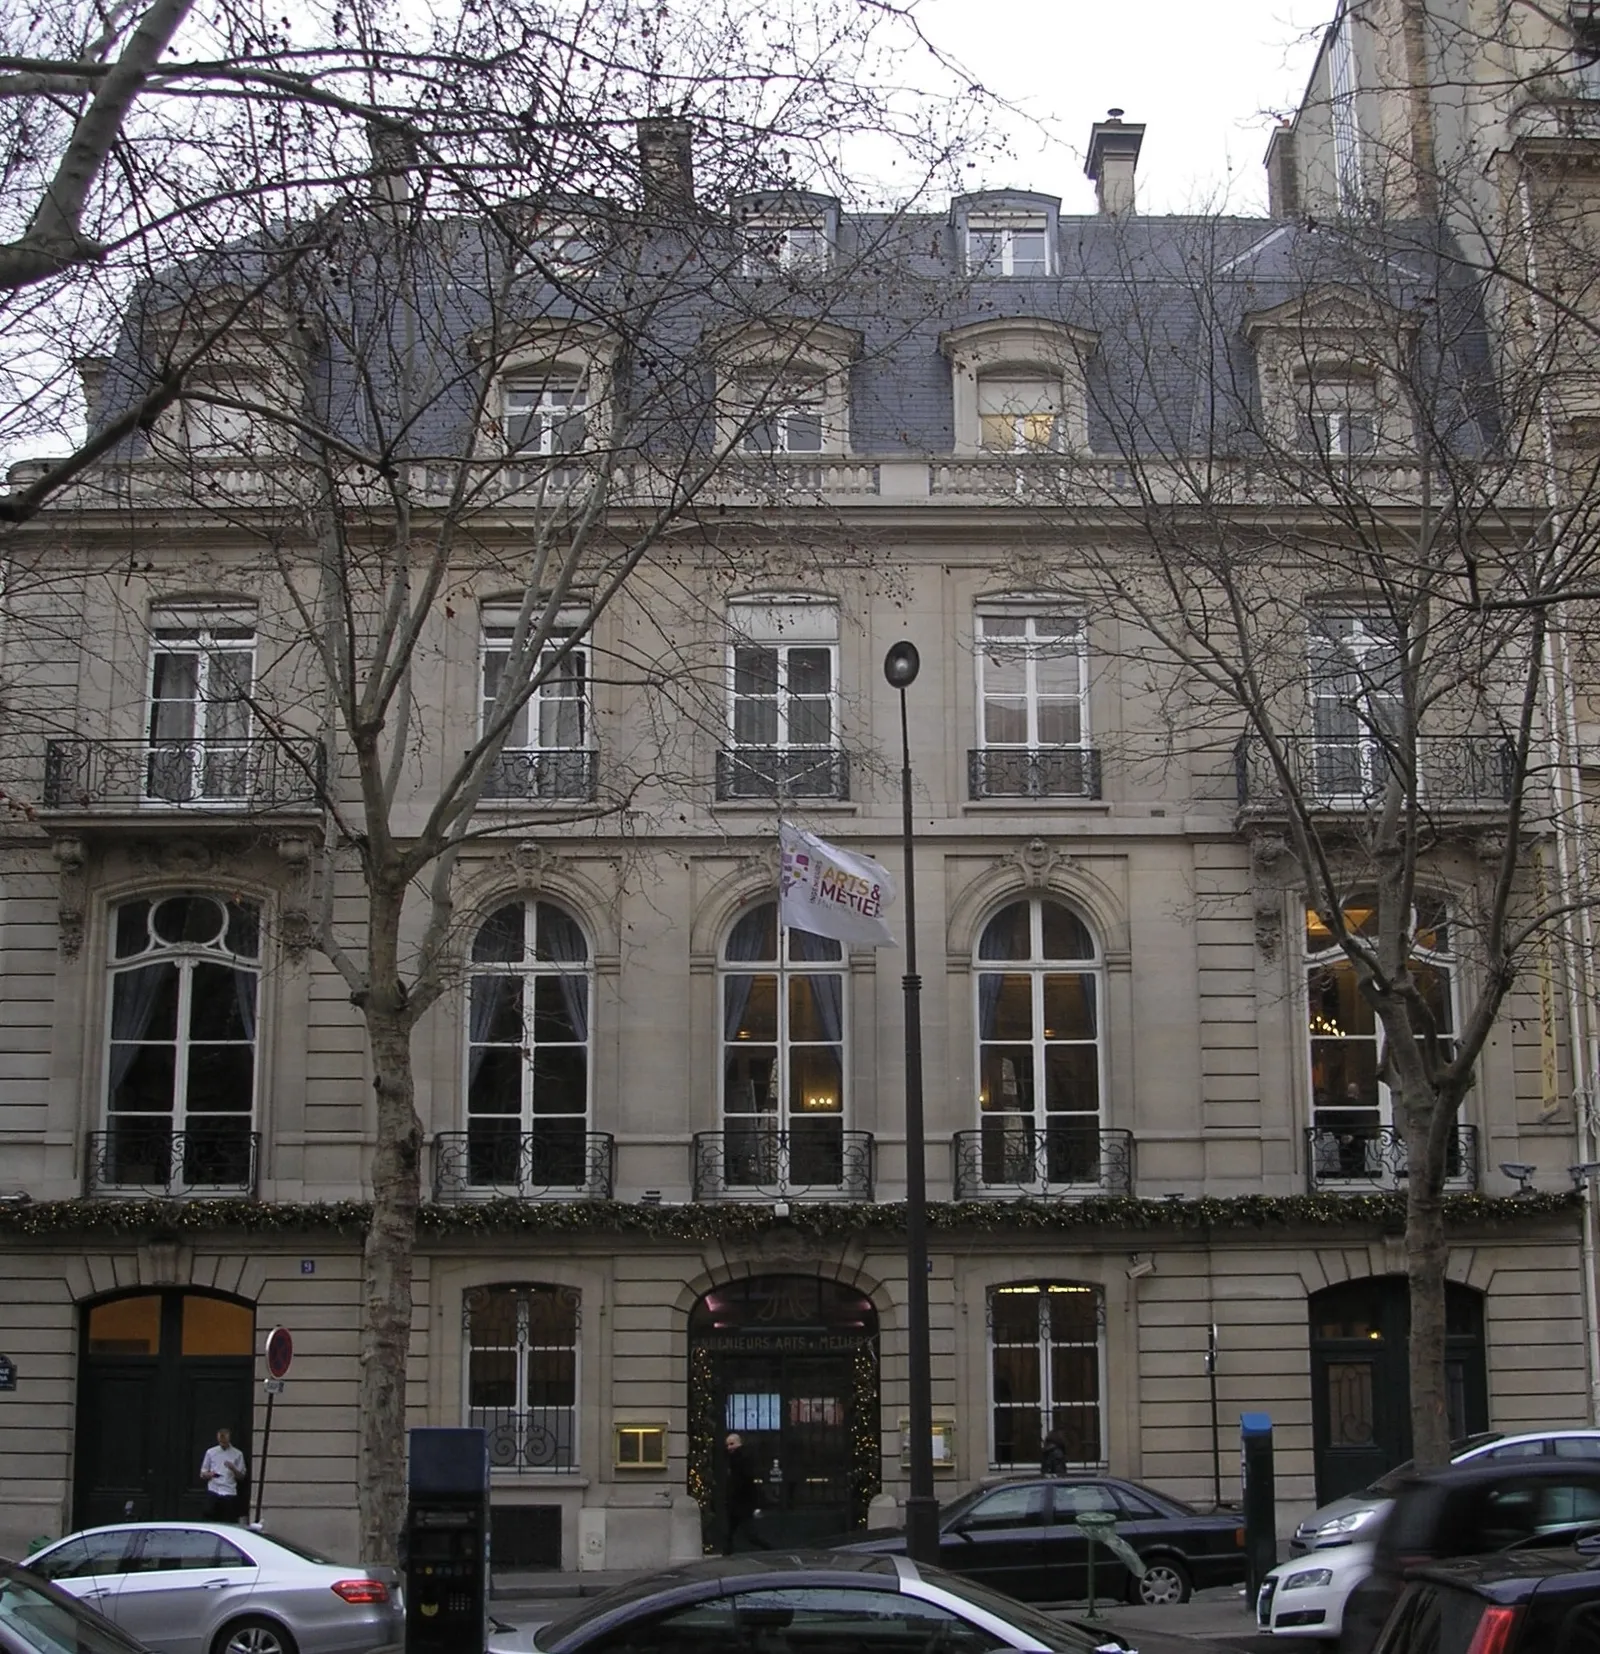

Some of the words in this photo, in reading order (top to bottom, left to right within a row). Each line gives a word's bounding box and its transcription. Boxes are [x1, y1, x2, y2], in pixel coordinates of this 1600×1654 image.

[823, 866, 870, 896] ARTS
[870, 884, 881, 901] &
[775, 1336, 806, 1350] ARTS
